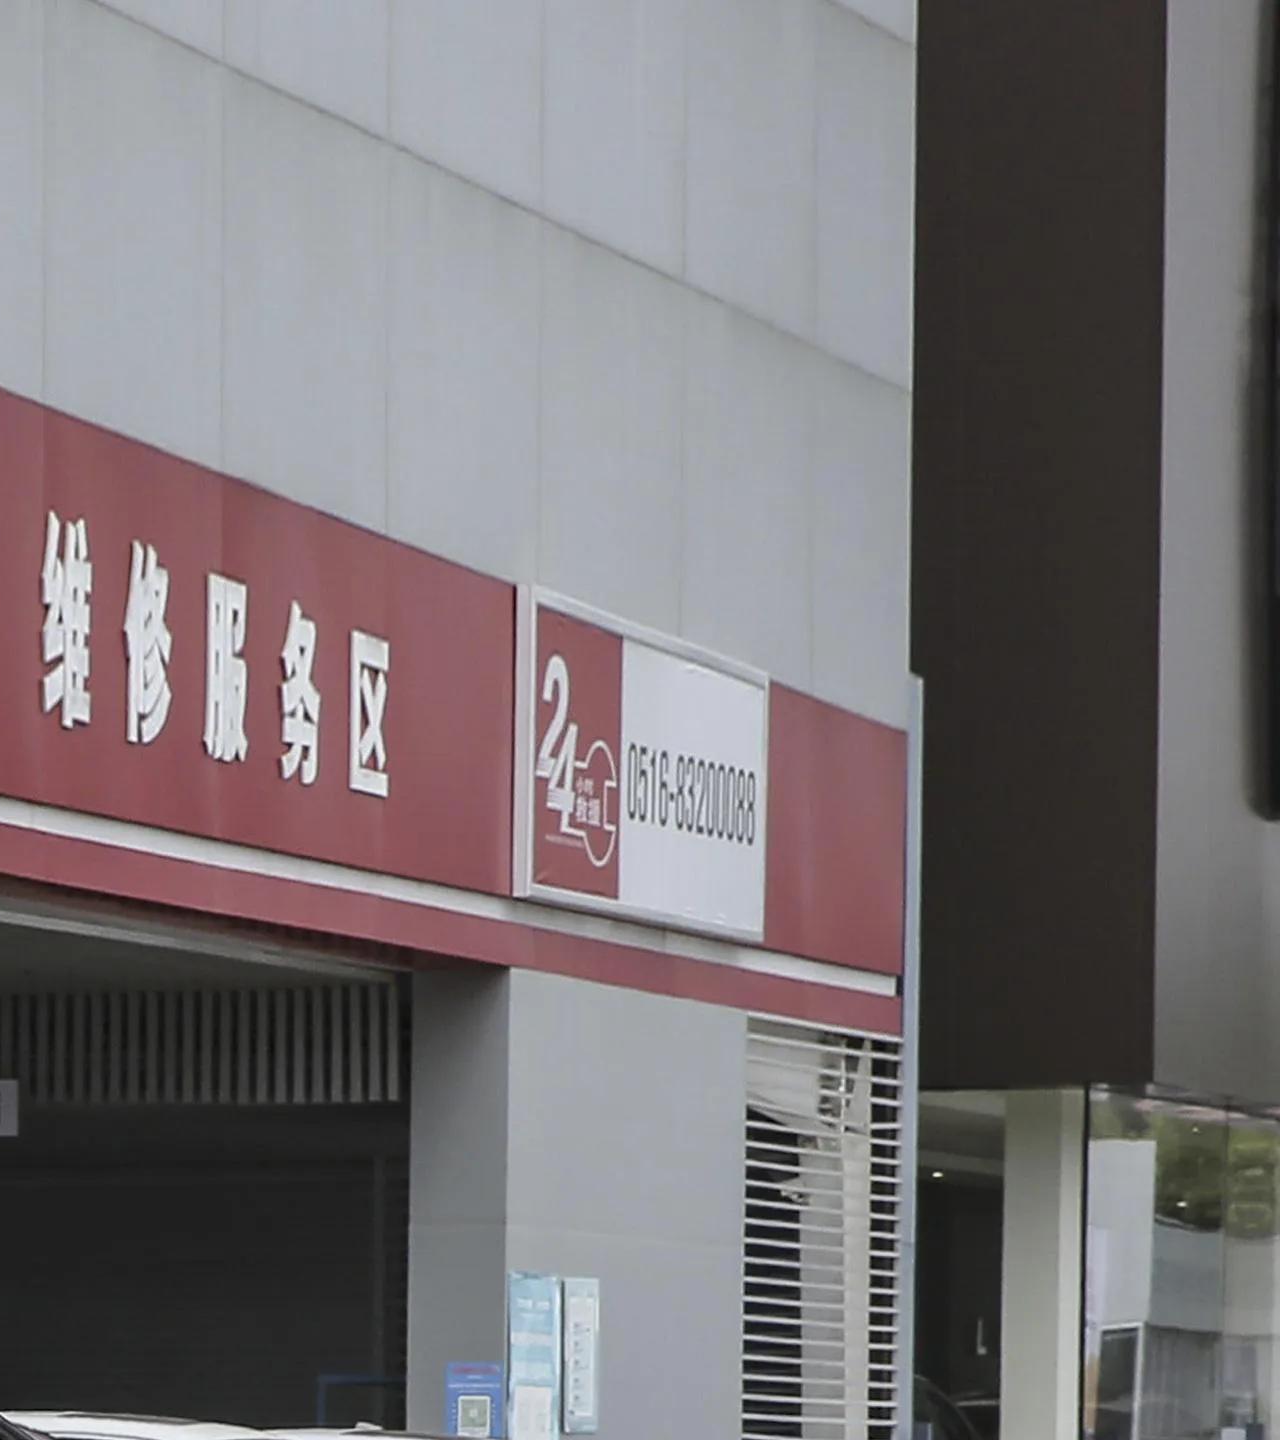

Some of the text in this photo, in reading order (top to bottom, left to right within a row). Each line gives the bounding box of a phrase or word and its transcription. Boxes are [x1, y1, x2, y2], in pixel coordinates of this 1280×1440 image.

[42, 509, 391, 798] 维修服务区
[536, 655, 579, 834] 24
[627, 742, 756, 847] 0516-83200088
